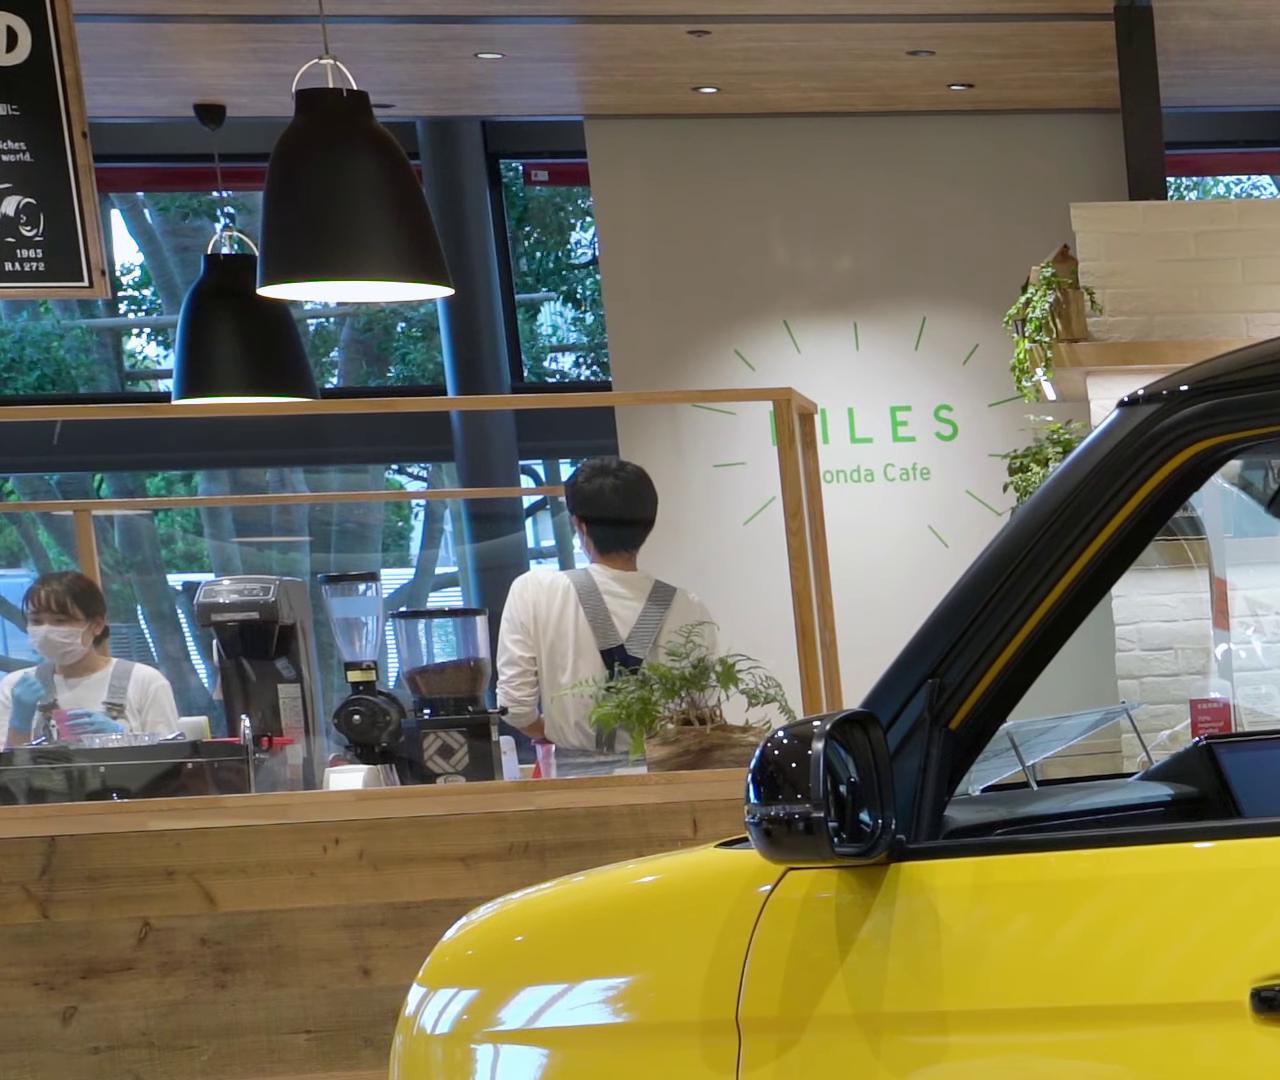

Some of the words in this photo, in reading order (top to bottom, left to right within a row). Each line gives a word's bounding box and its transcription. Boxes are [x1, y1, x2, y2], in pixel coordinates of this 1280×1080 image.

[16, 249, 43, 258] 1965
[23, 262, 45, 271] 272
[770, 403, 959, 446] ILES
[822, 465, 875, 484] onda
[883, 462, 931, 482] Cafe
